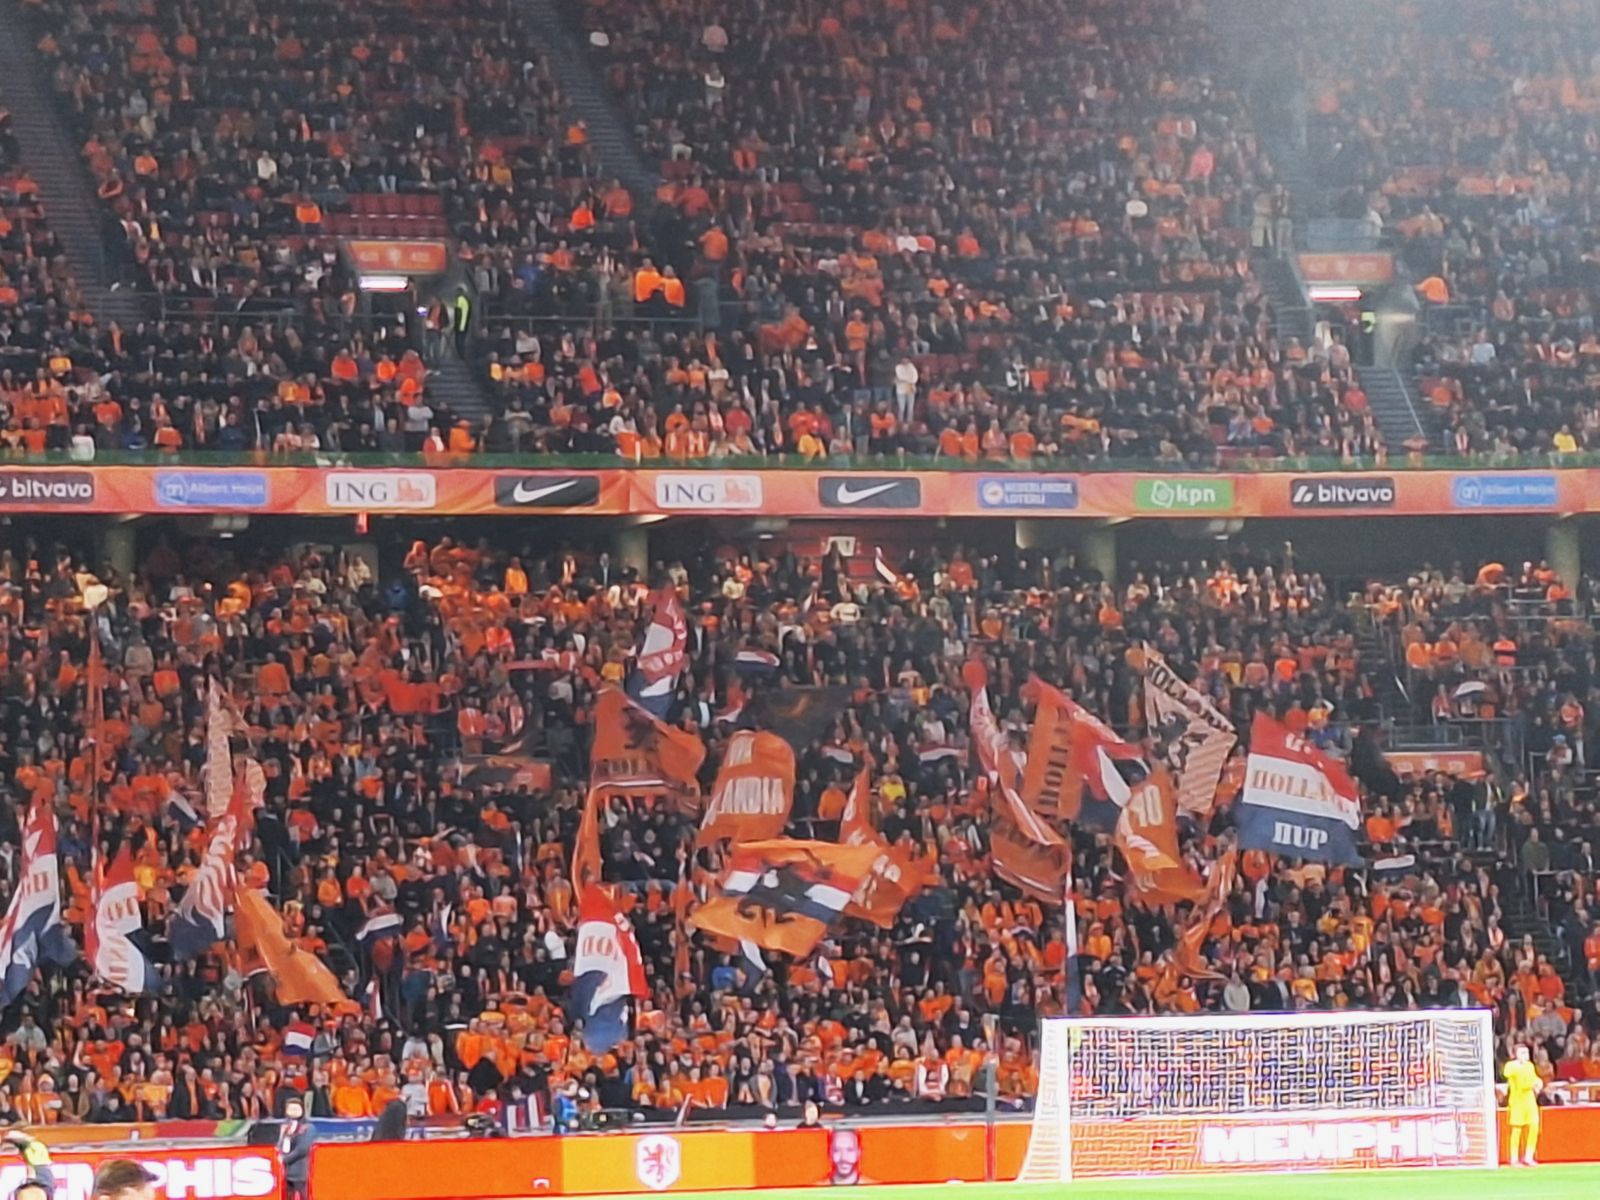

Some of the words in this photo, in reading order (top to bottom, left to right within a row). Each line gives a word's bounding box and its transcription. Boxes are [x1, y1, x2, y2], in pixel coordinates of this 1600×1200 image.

[12, 478, 92, 498] bitvavo
[334, 481, 388, 502] ING
[664, 483, 715, 503] ING
[1176, 484, 1216, 507] kpn
[1318, 483, 1393, 502] bitvavo
[1272, 821, 1328, 850] HUP
[1203, 1120, 1470, 1162] MEMPHIS
